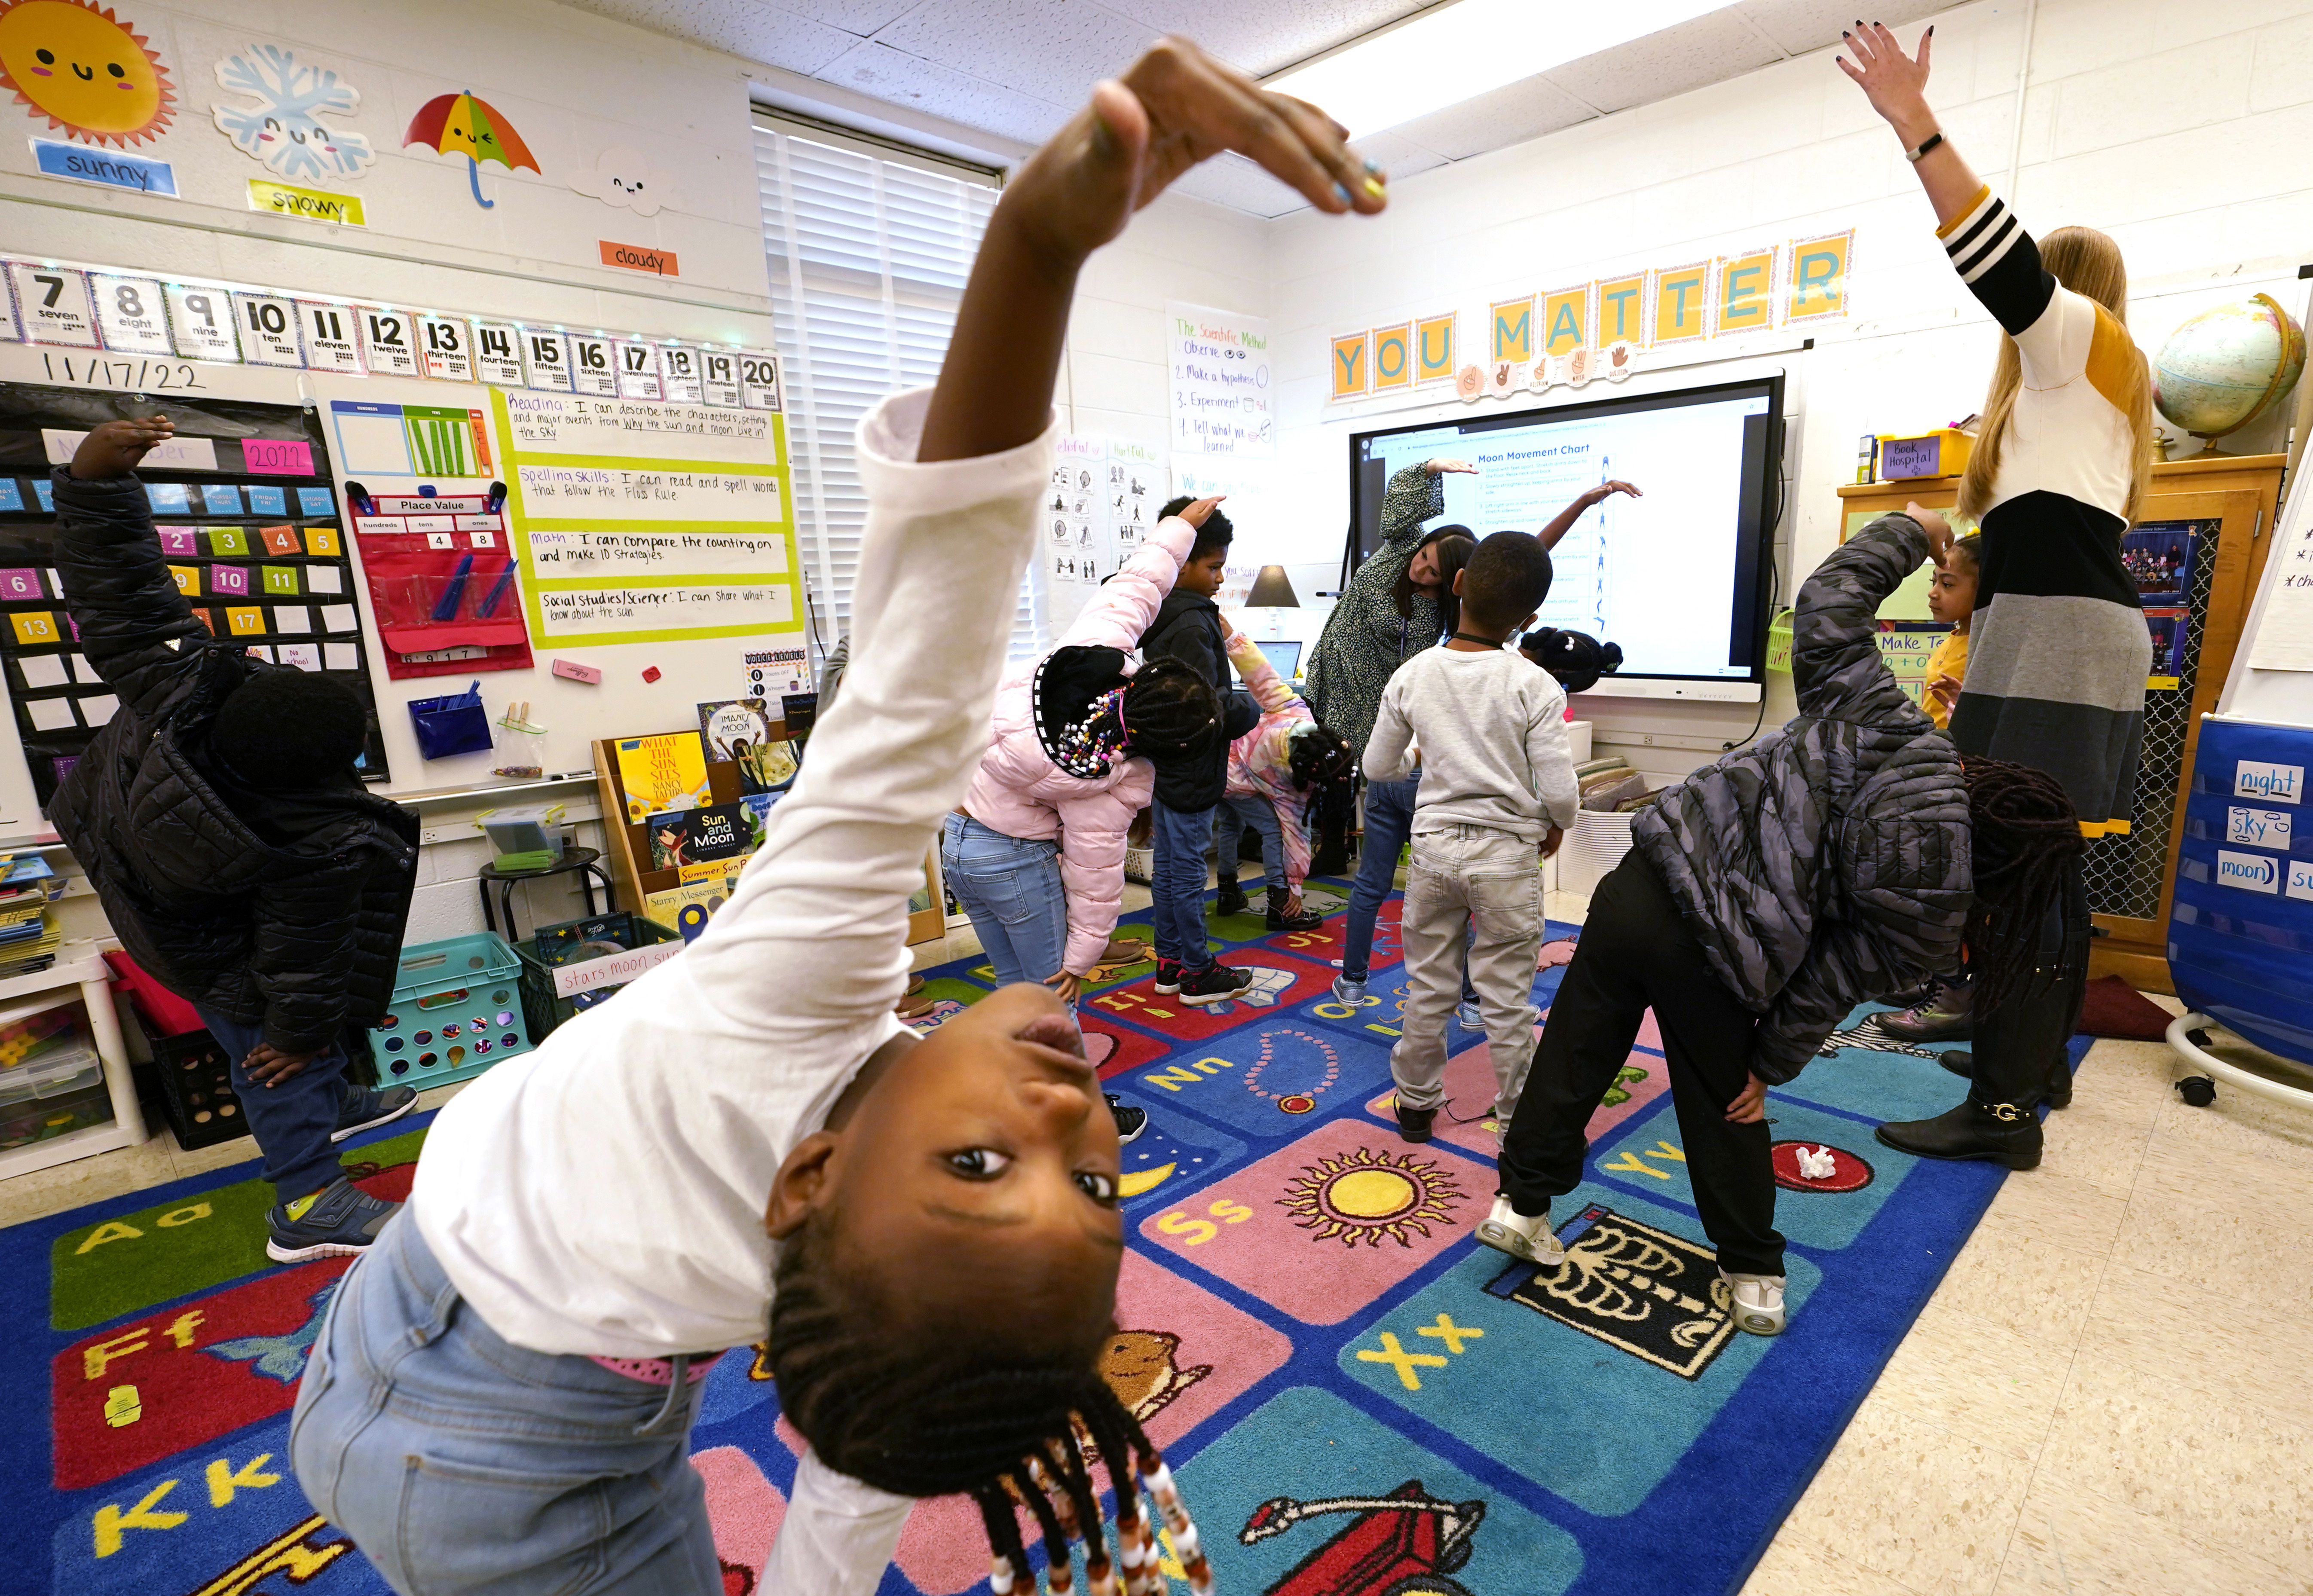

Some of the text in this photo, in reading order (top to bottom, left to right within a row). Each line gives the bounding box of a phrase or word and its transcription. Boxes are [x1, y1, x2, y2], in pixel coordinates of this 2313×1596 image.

[67, 155, 148, 191] sunny
[273, 191, 345, 225] snowy
[615, 248, 664, 276] cloudy
[35, 275, 63, 308] 7
[116, 286, 144, 317] 8
[38, 310, 79, 321] seven
[185, 294, 215, 326] 9
[247, 303, 285, 333] 10
[1336, 251, 1840, 385] YOU MATTER
[119, 317, 151, 330] eight
[193, 326, 217, 337] nine
[314, 311, 342, 339] 11
[369, 315, 404, 345] 12
[262, 333, 281, 343] ten
[428, 323, 459, 351] 13
[1176, 318, 1266, 349] The Scientific Method
[315, 340, 351, 350] eleven
[373, 344, 407, 354] twelve
[480, 329, 511, 357] 14
[532, 336, 559, 362] 15
[1184, 340, 1220, 358] Observe
[428, 350, 466, 361] thirteen
[480, 355, 520, 366] fourteen
[578, 342, 605, 368] 16
[624, 346, 646, 370] 17
[44, 353, 206, 388] 11/17/22
[535, 362, 563, 371] fifteen
[581, 367, 610, 376] sixteen
[667, 352, 691, 375] 18
[708, 356, 730, 381] 19
[743, 360, 773, 384] 20
[1187, 364, 1254, 386] Make hypothesis
[707, 379, 735, 388] nineteen
[575, 401, 587, 413] I
[595, 404, 612, 413] can
[619, 403, 661, 416] describe
[664, 408, 680, 417] the
[1191, 392, 1239, 412] Experiment
[514, 413, 733, 435] and major events from Why the sun and moon
[1193, 419, 1245, 438] Tell what we
[519, 427, 535, 438] the
[1204, 436, 1233, 452] learned
[1894, 442, 1918, 454] Book
[250, 446, 306, 467] 2022
[1479, 444, 1589, 463] Moon Movement Chart
[1890, 449, 1931, 468] Hospital
[621, 473, 630, 483] I
[640, 475, 661, 485] can
[670, 474, 692, 487] read
[699, 477, 718, 488] and
[724, 479, 747, 493] spell
[753, 481, 776, 492] words
[532, 484, 678, 500] that follow the Floss Rule.
[401, 501, 464, 510] Place Value
[172, 534, 184, 548] 2
[223, 534, 235, 548] 3
[276, 533, 288, 547] 4
[318, 535, 328, 549] 5
[436, 536, 443, 545] 4
[480, 535, 486, 544] 8
[579, 534, 590, 544] I
[597, 536, 619, 545] can
[624, 536, 678, 550] compare
[682, 536, 701, 547] the
[707, 538, 755, 553] counting
[540, 549, 609, 561] and 10
[10, 576, 27, 593] 6
[219, 572, 241, 587] 10
[272, 573, 289, 587] 11
[544, 594, 575, 606] Social
[676, 591, 687, 602] I
[572, 608, 594, 619] about
[599, 606, 613, 617] the
[23, 620, 48, 636] 13
[236, 614, 255, 628] 17
[1882, 635, 1921, 650] Make
[746, 651, 805, 664] VOICE LEVELS
[721, 713, 750, 722] IMANI'S
[721, 723, 750, 732] MOON
[640, 736, 677, 749] WHAT
[649, 748, 673, 758] THE
[651, 758, 676, 770] SUN
[651, 769, 680, 781] SEES
[2241, 769, 2295, 796] night
[653, 780, 681, 790] NANCY
[654, 788, 683, 799] TAFURI
[702, 815, 726, 826] Sun
[708, 821, 731, 835] and
[2233, 815, 2267, 841] sky
[694, 833, 734, 847] Moon
[682, 863, 738, 881] Summer Sun
[2222, 862, 2266, 881] moon
[651, 886, 723, 907] Starry Messenger
[565, 955, 647, 988] stars moon
